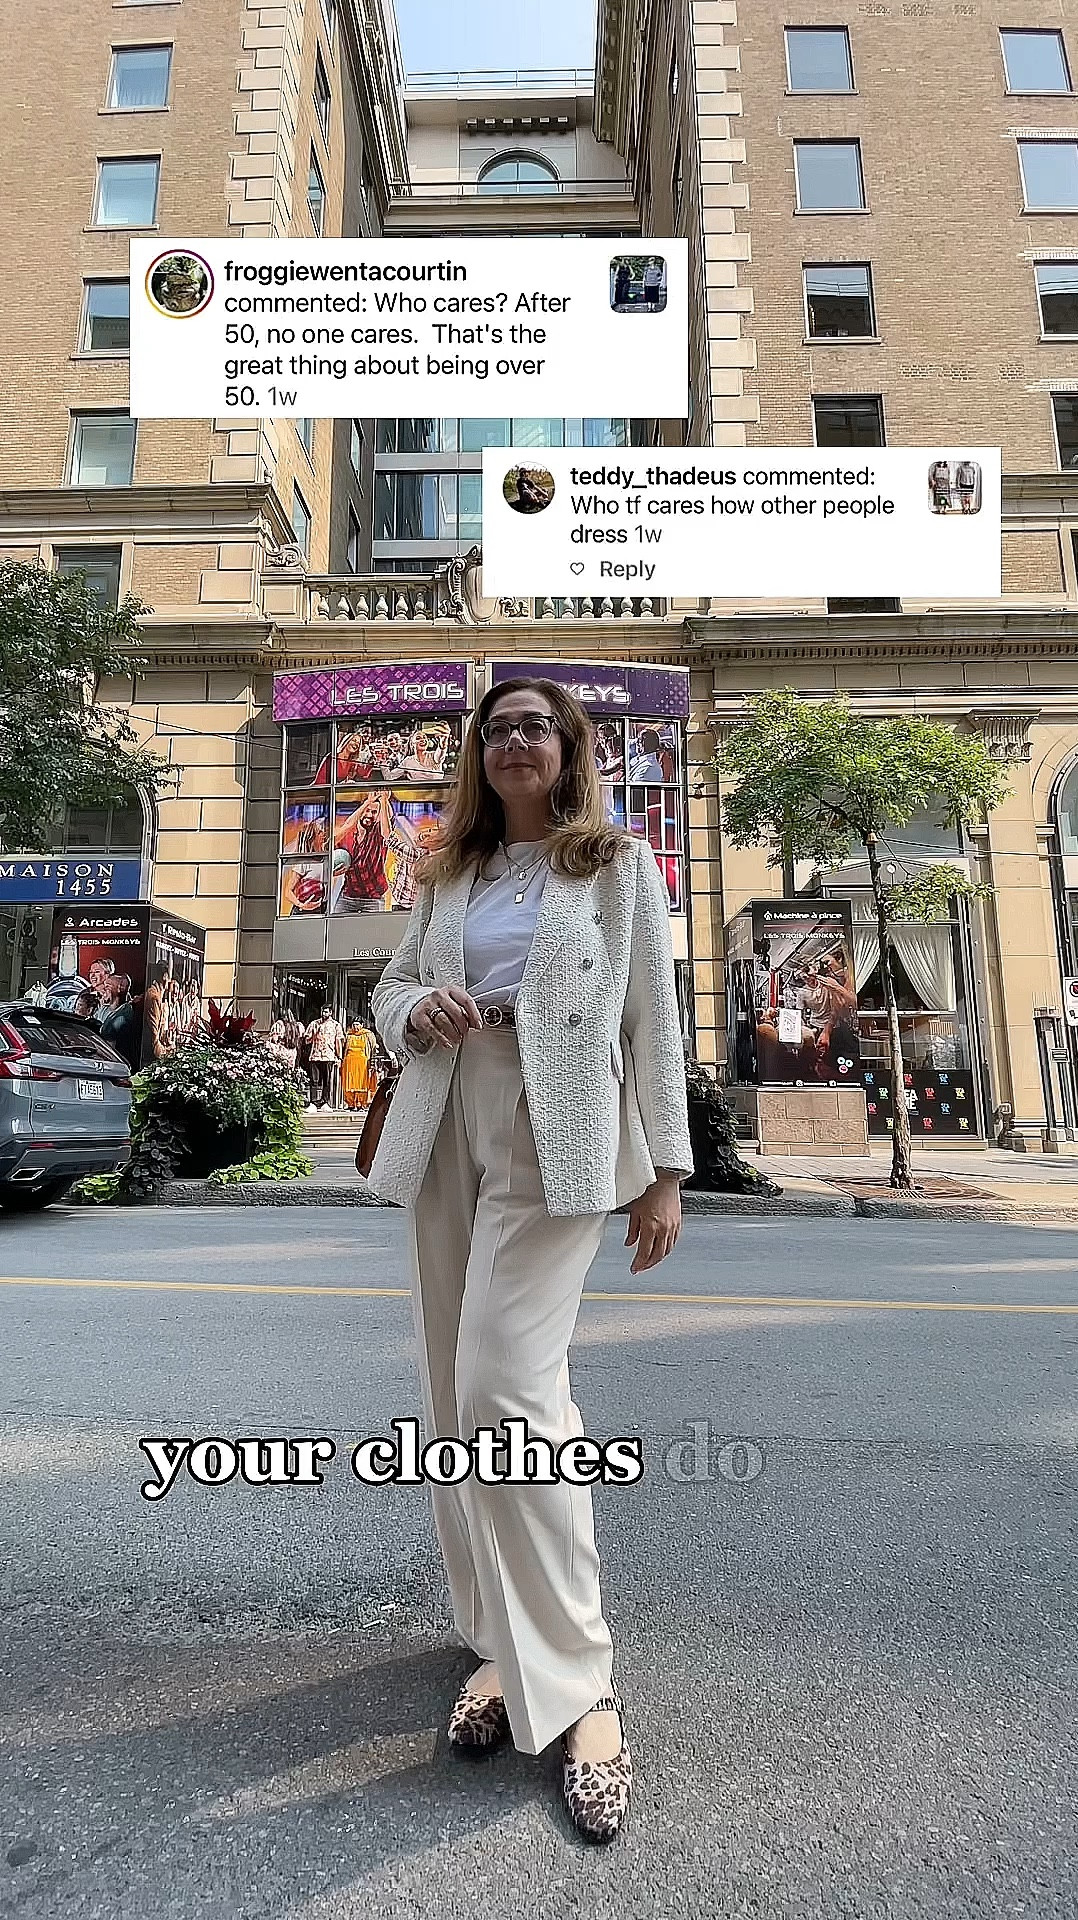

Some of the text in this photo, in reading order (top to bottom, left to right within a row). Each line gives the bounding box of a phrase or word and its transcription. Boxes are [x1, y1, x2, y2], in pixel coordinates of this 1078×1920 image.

[331, 682, 464, 705] LES TROIS
[562, 683, 631, 705] KEYS
[0, 863, 114, 878] MAISON
[56, 879, 112, 897] 1455
[79, 917, 139, 928] Arcades
[773, 911, 810, 920] Machine
[372, 947, 397, 956] Cour
